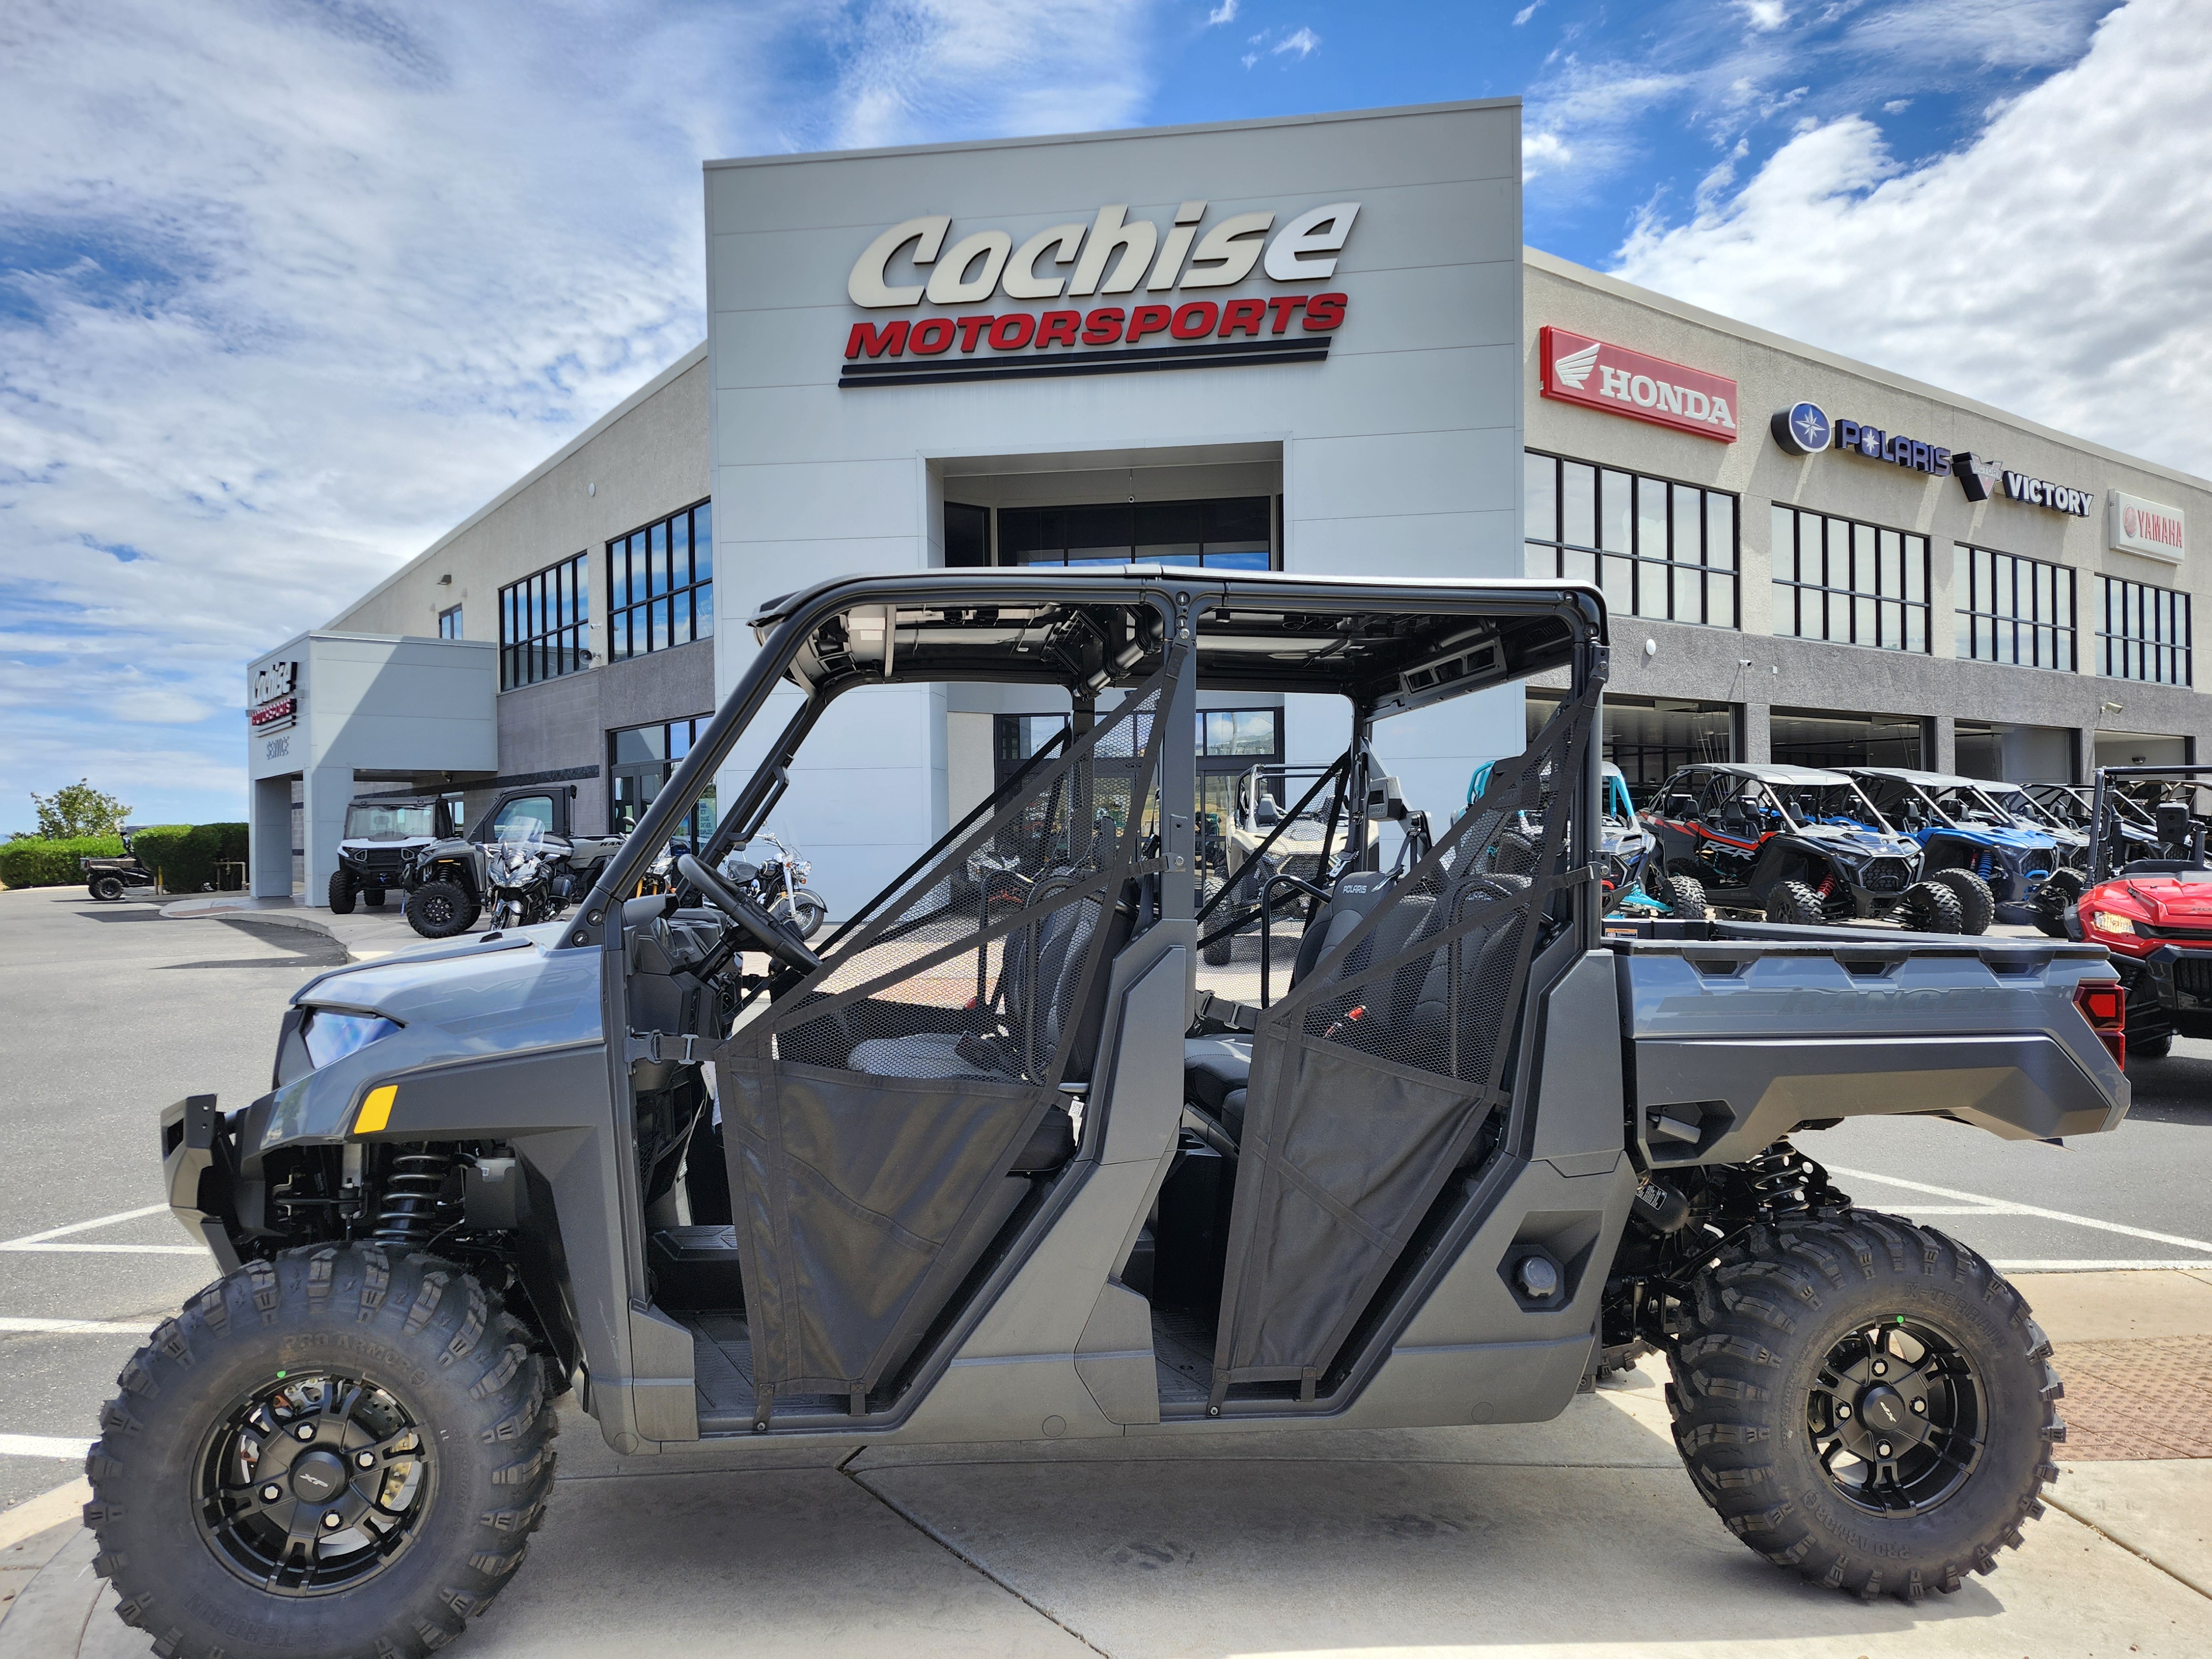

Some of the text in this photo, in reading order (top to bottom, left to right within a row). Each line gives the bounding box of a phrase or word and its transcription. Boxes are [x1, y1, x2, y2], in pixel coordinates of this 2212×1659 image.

[848, 199, 1362, 308] Cochise
[844, 292, 1348, 359] MOTORSPORTS
[1599, 365, 1736, 429] HONDA
[1836, 419, 1953, 477] POLARIS
[1972, 463, 2001, 478] VICTORY
[2006, 471, 2094, 518] VICTORY
[2138, 509, 2183, 548] YAMAHA
[1702, 840, 1756, 860] RZR
[1343, 885, 1368, 894] POLARIS
[1902, 1282, 2009, 1350] X-TERRAIN
[1880, 1401, 1897, 1423] XP
[299, 1473, 328, 1487] XP
[1815, 1504, 1911, 1559] PRO ARMOR
[183, 1592, 330, 1649] X-TERRAIN
